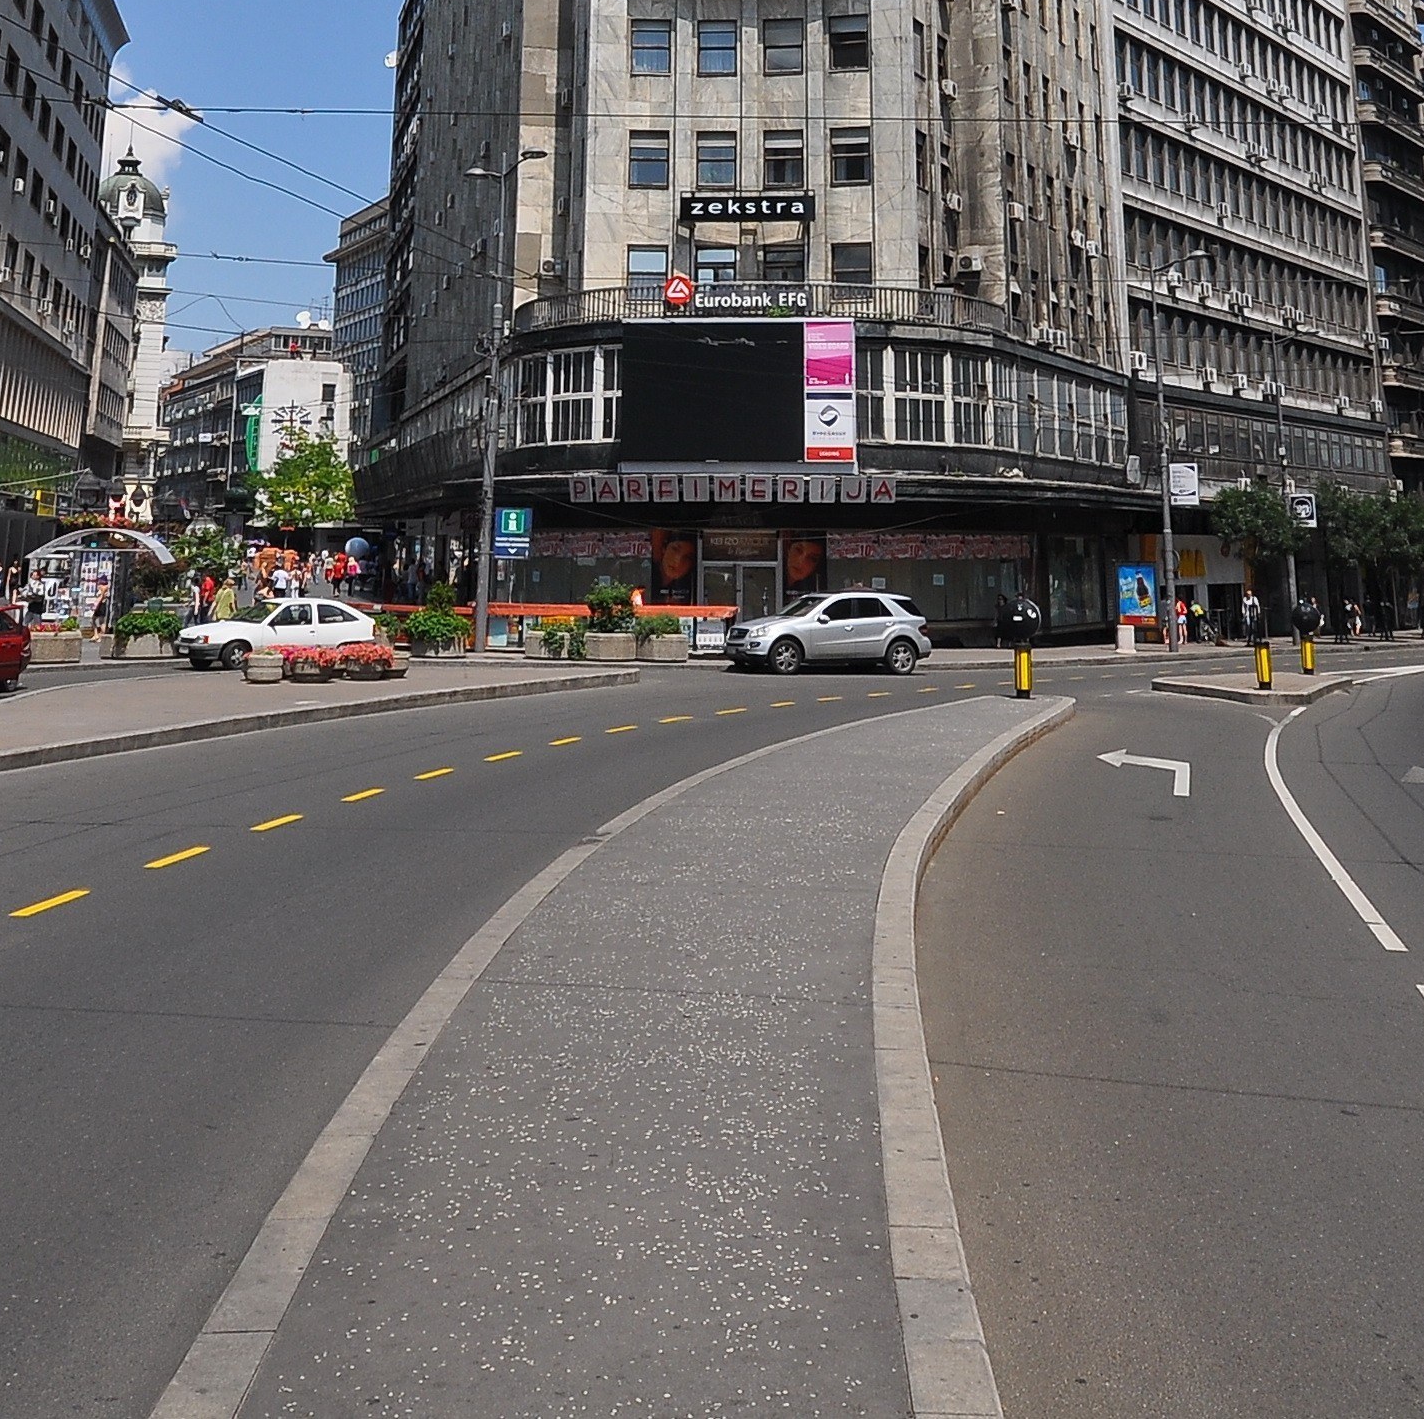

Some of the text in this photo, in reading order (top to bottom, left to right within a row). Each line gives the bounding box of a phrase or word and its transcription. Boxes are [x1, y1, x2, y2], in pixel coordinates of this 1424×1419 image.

[690, 199, 806, 215] zekstra
[695, 292, 807, 308] Eurobank EFG
[573, 479, 894, 501] PARFIMERIJA
